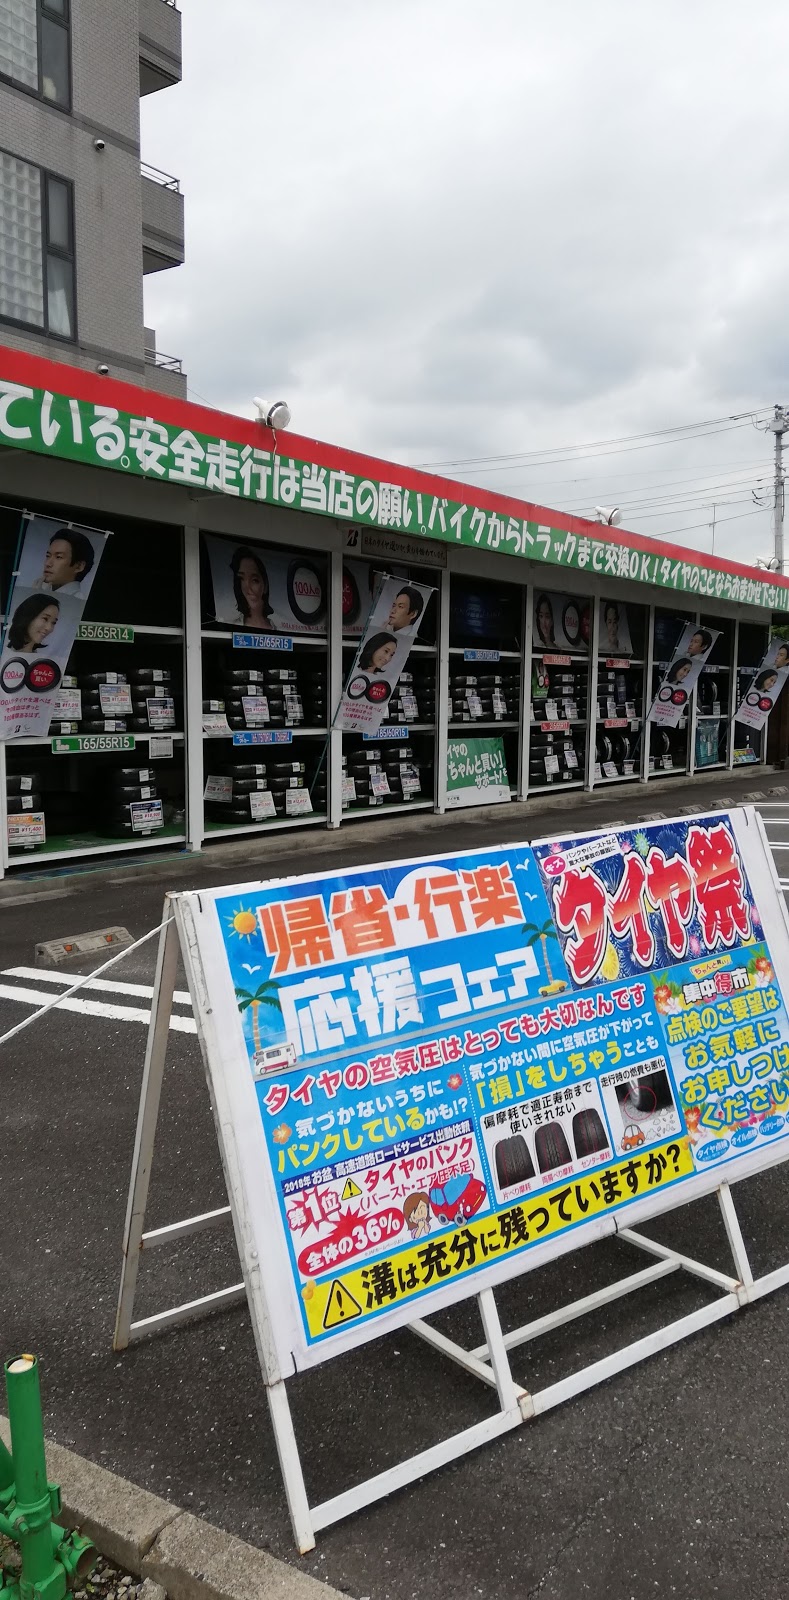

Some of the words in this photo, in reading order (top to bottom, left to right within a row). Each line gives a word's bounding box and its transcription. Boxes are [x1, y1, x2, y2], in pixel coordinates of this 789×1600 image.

[294, 581, 320, 594] 100人の
[76, 622, 130, 641] 155/65R14
[250, 636, 289, 649] 175/65R15
[33, 669, 54, 678] ちゃんと
[78, 736, 130, 750] 165/55R15
[566, 836, 618, 859] パンクやバーストなど
[568, 845, 617, 866] 重大な事故の原因に
[257, 861, 524, 975] 帰省・行楽
[552, 820, 750, 987] タイヤ祭
[682, 967, 750, 1005] 集中得市
[668, 989, 780, 1044] 点検のご要望は
[263, 983, 646, 1116] タイヤの空気圧はとっても大切なんです
[469, 1012, 654, 1081] 気づかない間に空気圧が下がって
[685, 1018, 780, 1070] お気軽に
[475, 1035, 659, 1109] 「損」をしちゃうことも
[601, 1056, 666, 1089] 走行時の燃費も悪化
[681, 1044, 789, 1106] お申しつけ
[295, 1078, 444, 1139] 気づかないうちに
[483, 1082, 593, 1129] 偏摩耗で適正寿命まで
[510, 1101, 577, 1134] 使いきれない
[277, 1096, 468, 1173] パンクしているかも!?
[284, 1177, 311, 1193] 2018年
[312, 1166, 334, 1188] お盆
[335, 1119, 471, 1177] 高速道路ロードサービス出動依頼
[697, 1138, 729, 1159] タイヤ点検
[731, 1128, 758, 1145] オイル点検
[363, 1137, 474, 1192] タイヤのパンク
[581, 1151, 611, 1168] センター摩耗
[287, 1190, 340, 1229] 第1位
[502, 1182, 532, 1201] 片べり摩耗
[305, 1210, 401, 1272] 全体の36%
[361, 1144, 682, 1310] 溝は充分に残っていますか?
